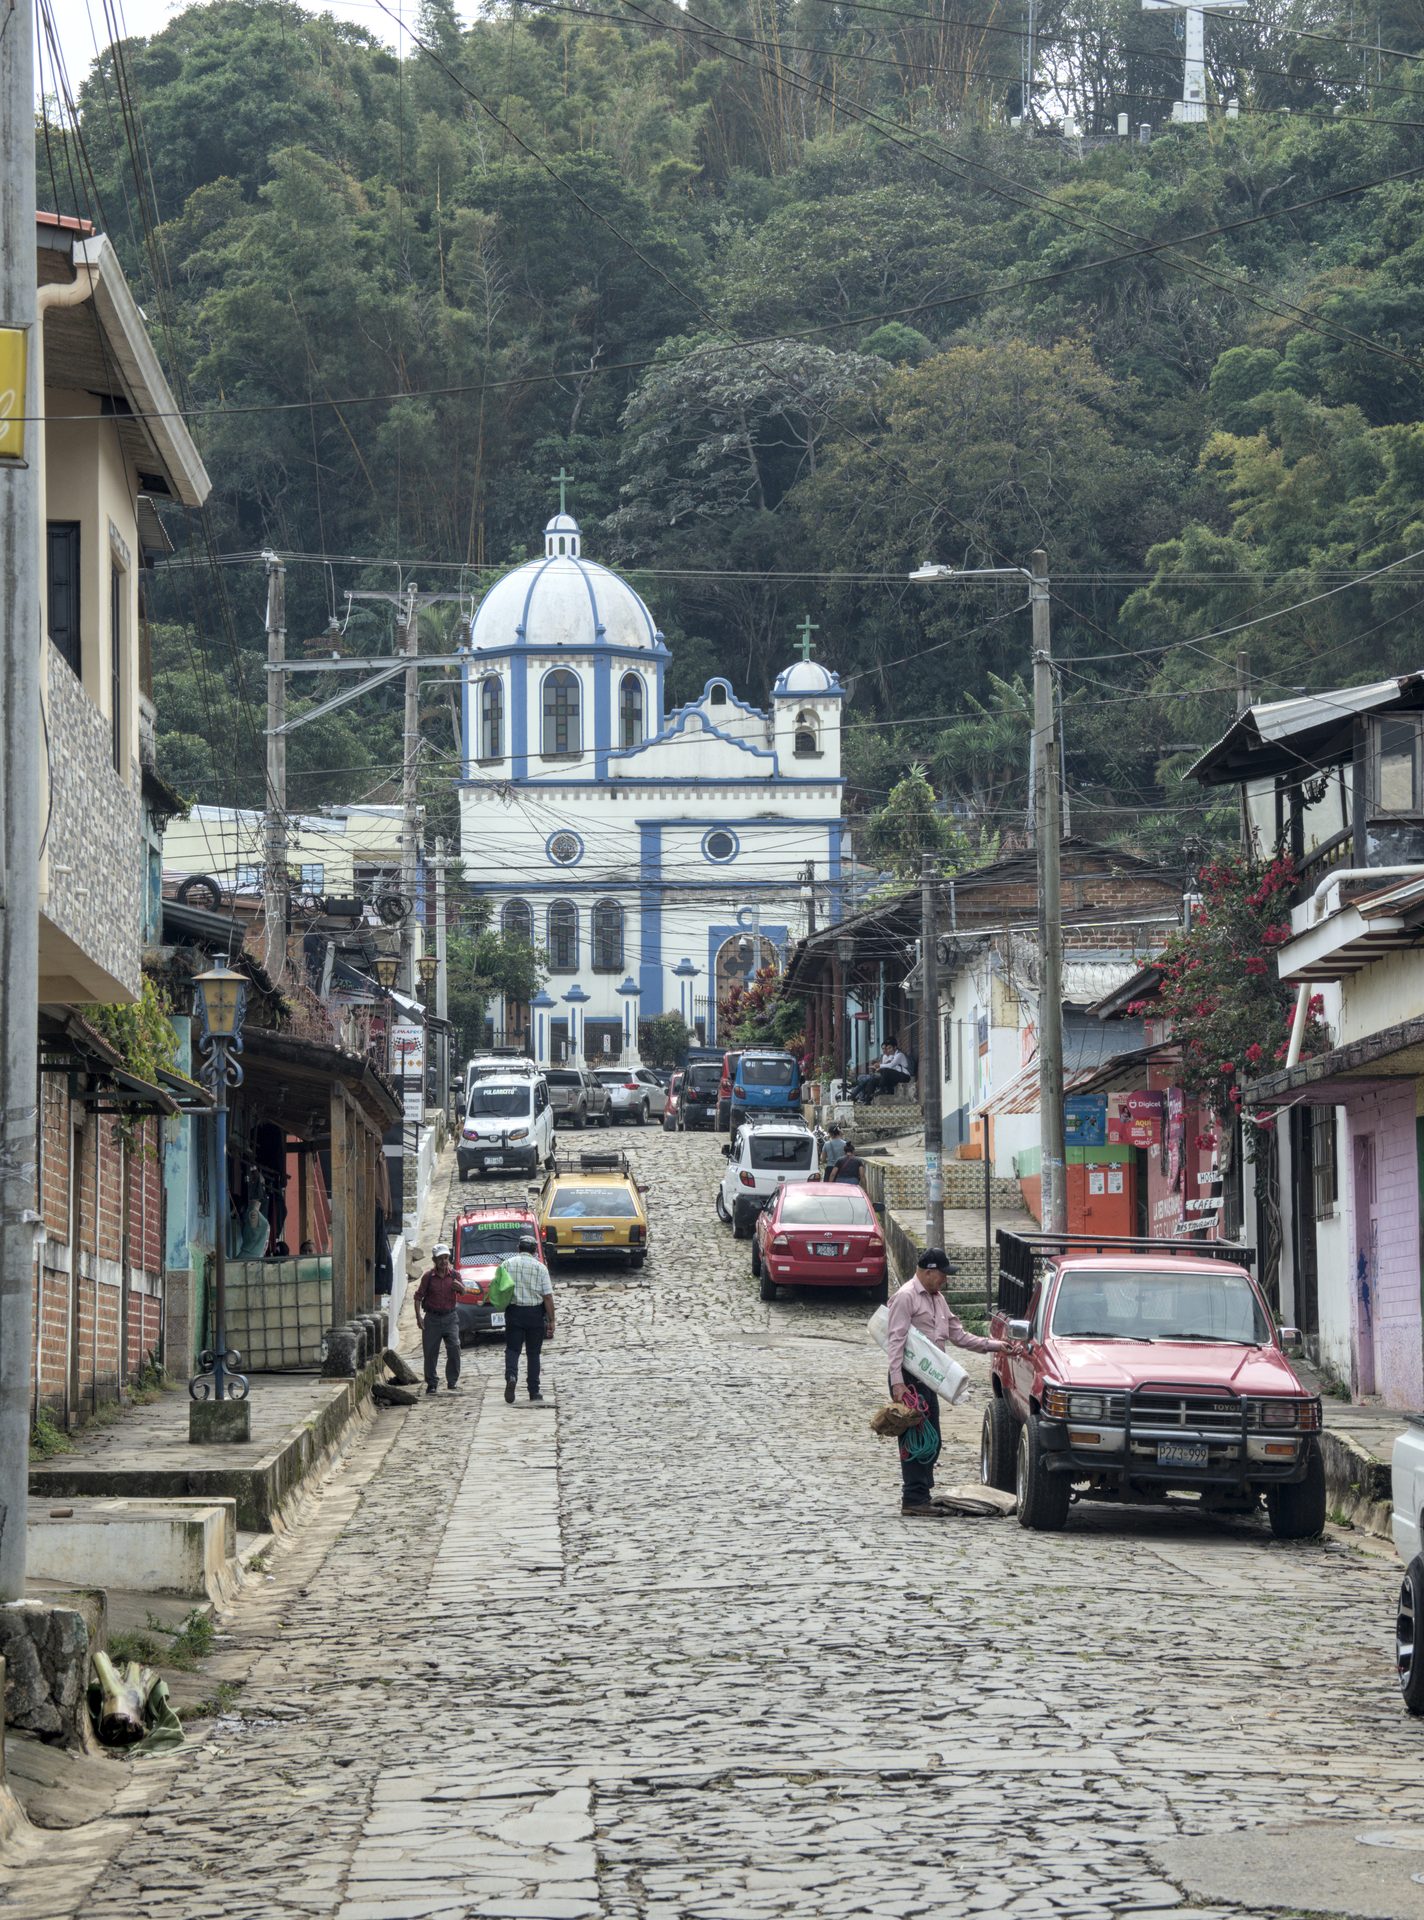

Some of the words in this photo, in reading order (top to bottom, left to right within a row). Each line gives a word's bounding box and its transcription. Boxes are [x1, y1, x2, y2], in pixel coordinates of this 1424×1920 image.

[1138, 1100, 1161, 1109] Digicel
[1200, 1172, 1221, 1182] HOST
[478, 1222, 520, 1231] GUERRERO
[1213, 1403, 1241, 1411] TOYOT
